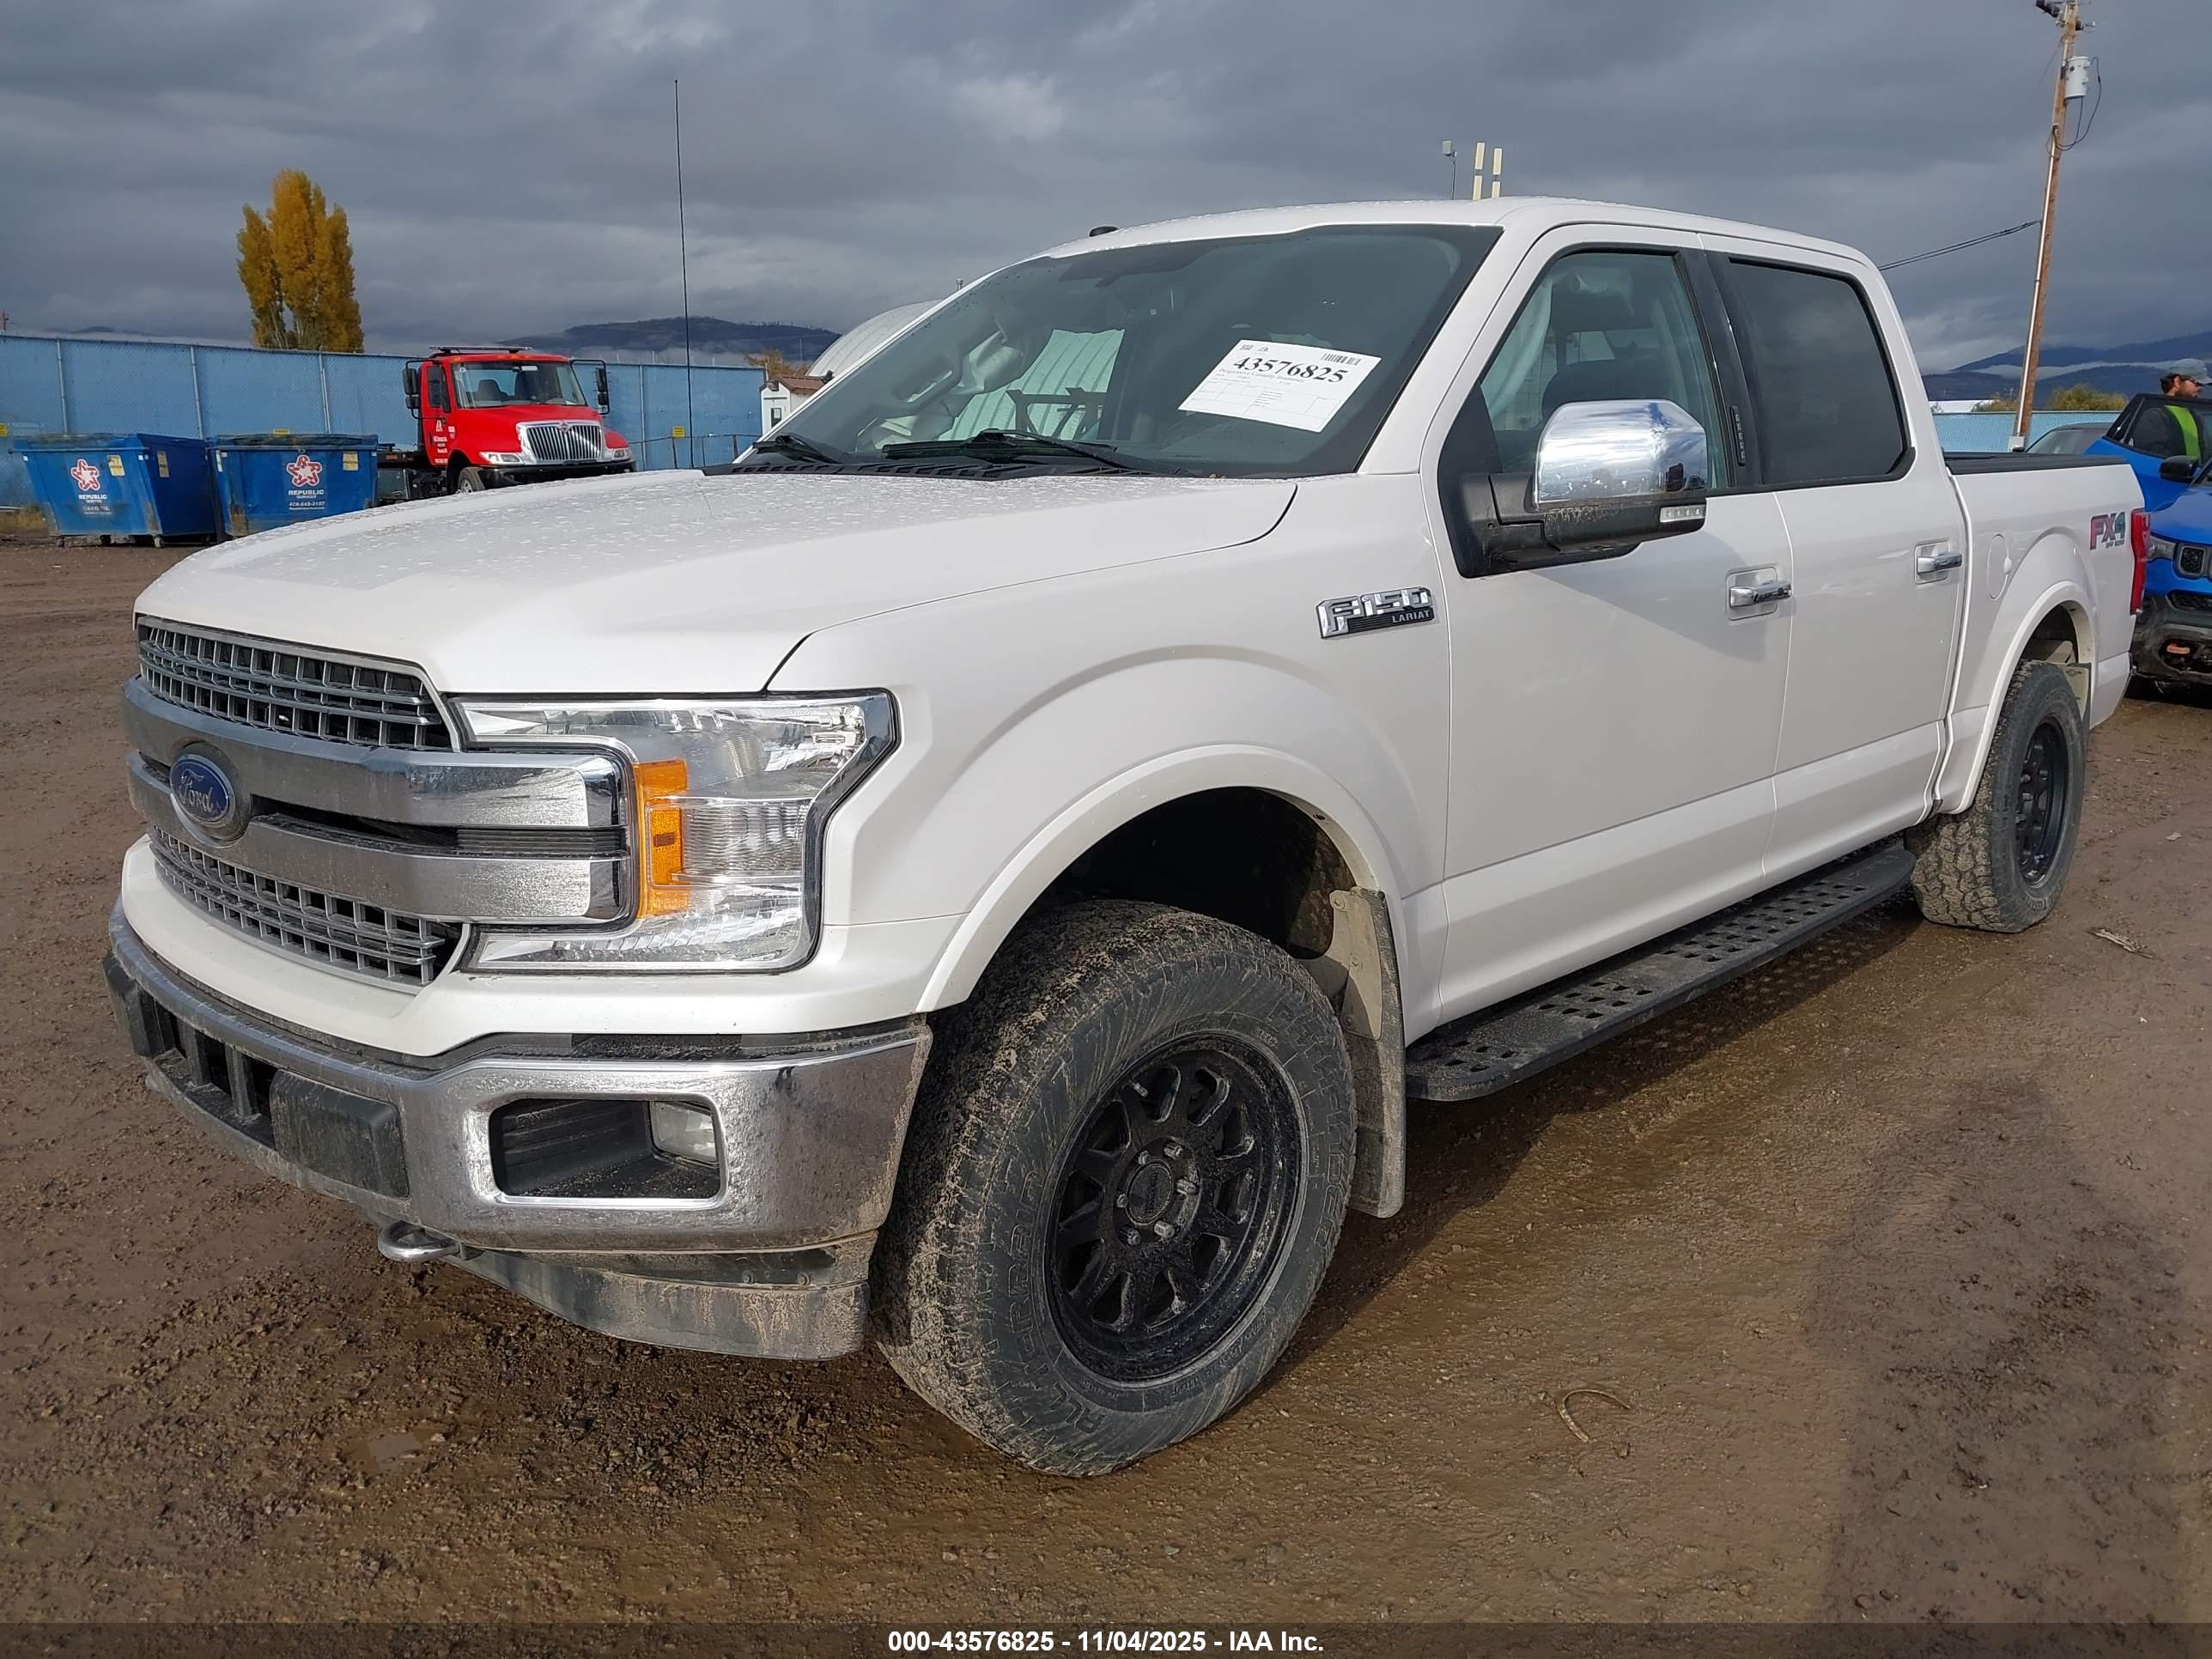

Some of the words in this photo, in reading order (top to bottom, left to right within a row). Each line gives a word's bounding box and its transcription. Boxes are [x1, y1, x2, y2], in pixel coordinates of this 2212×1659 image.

[1233, 356, 1349, 383] 43576825
[2089, 511, 2125, 550] FX4
[1391, 609, 1431, 624] LARIAT
[178, 768, 214, 813] Ford
